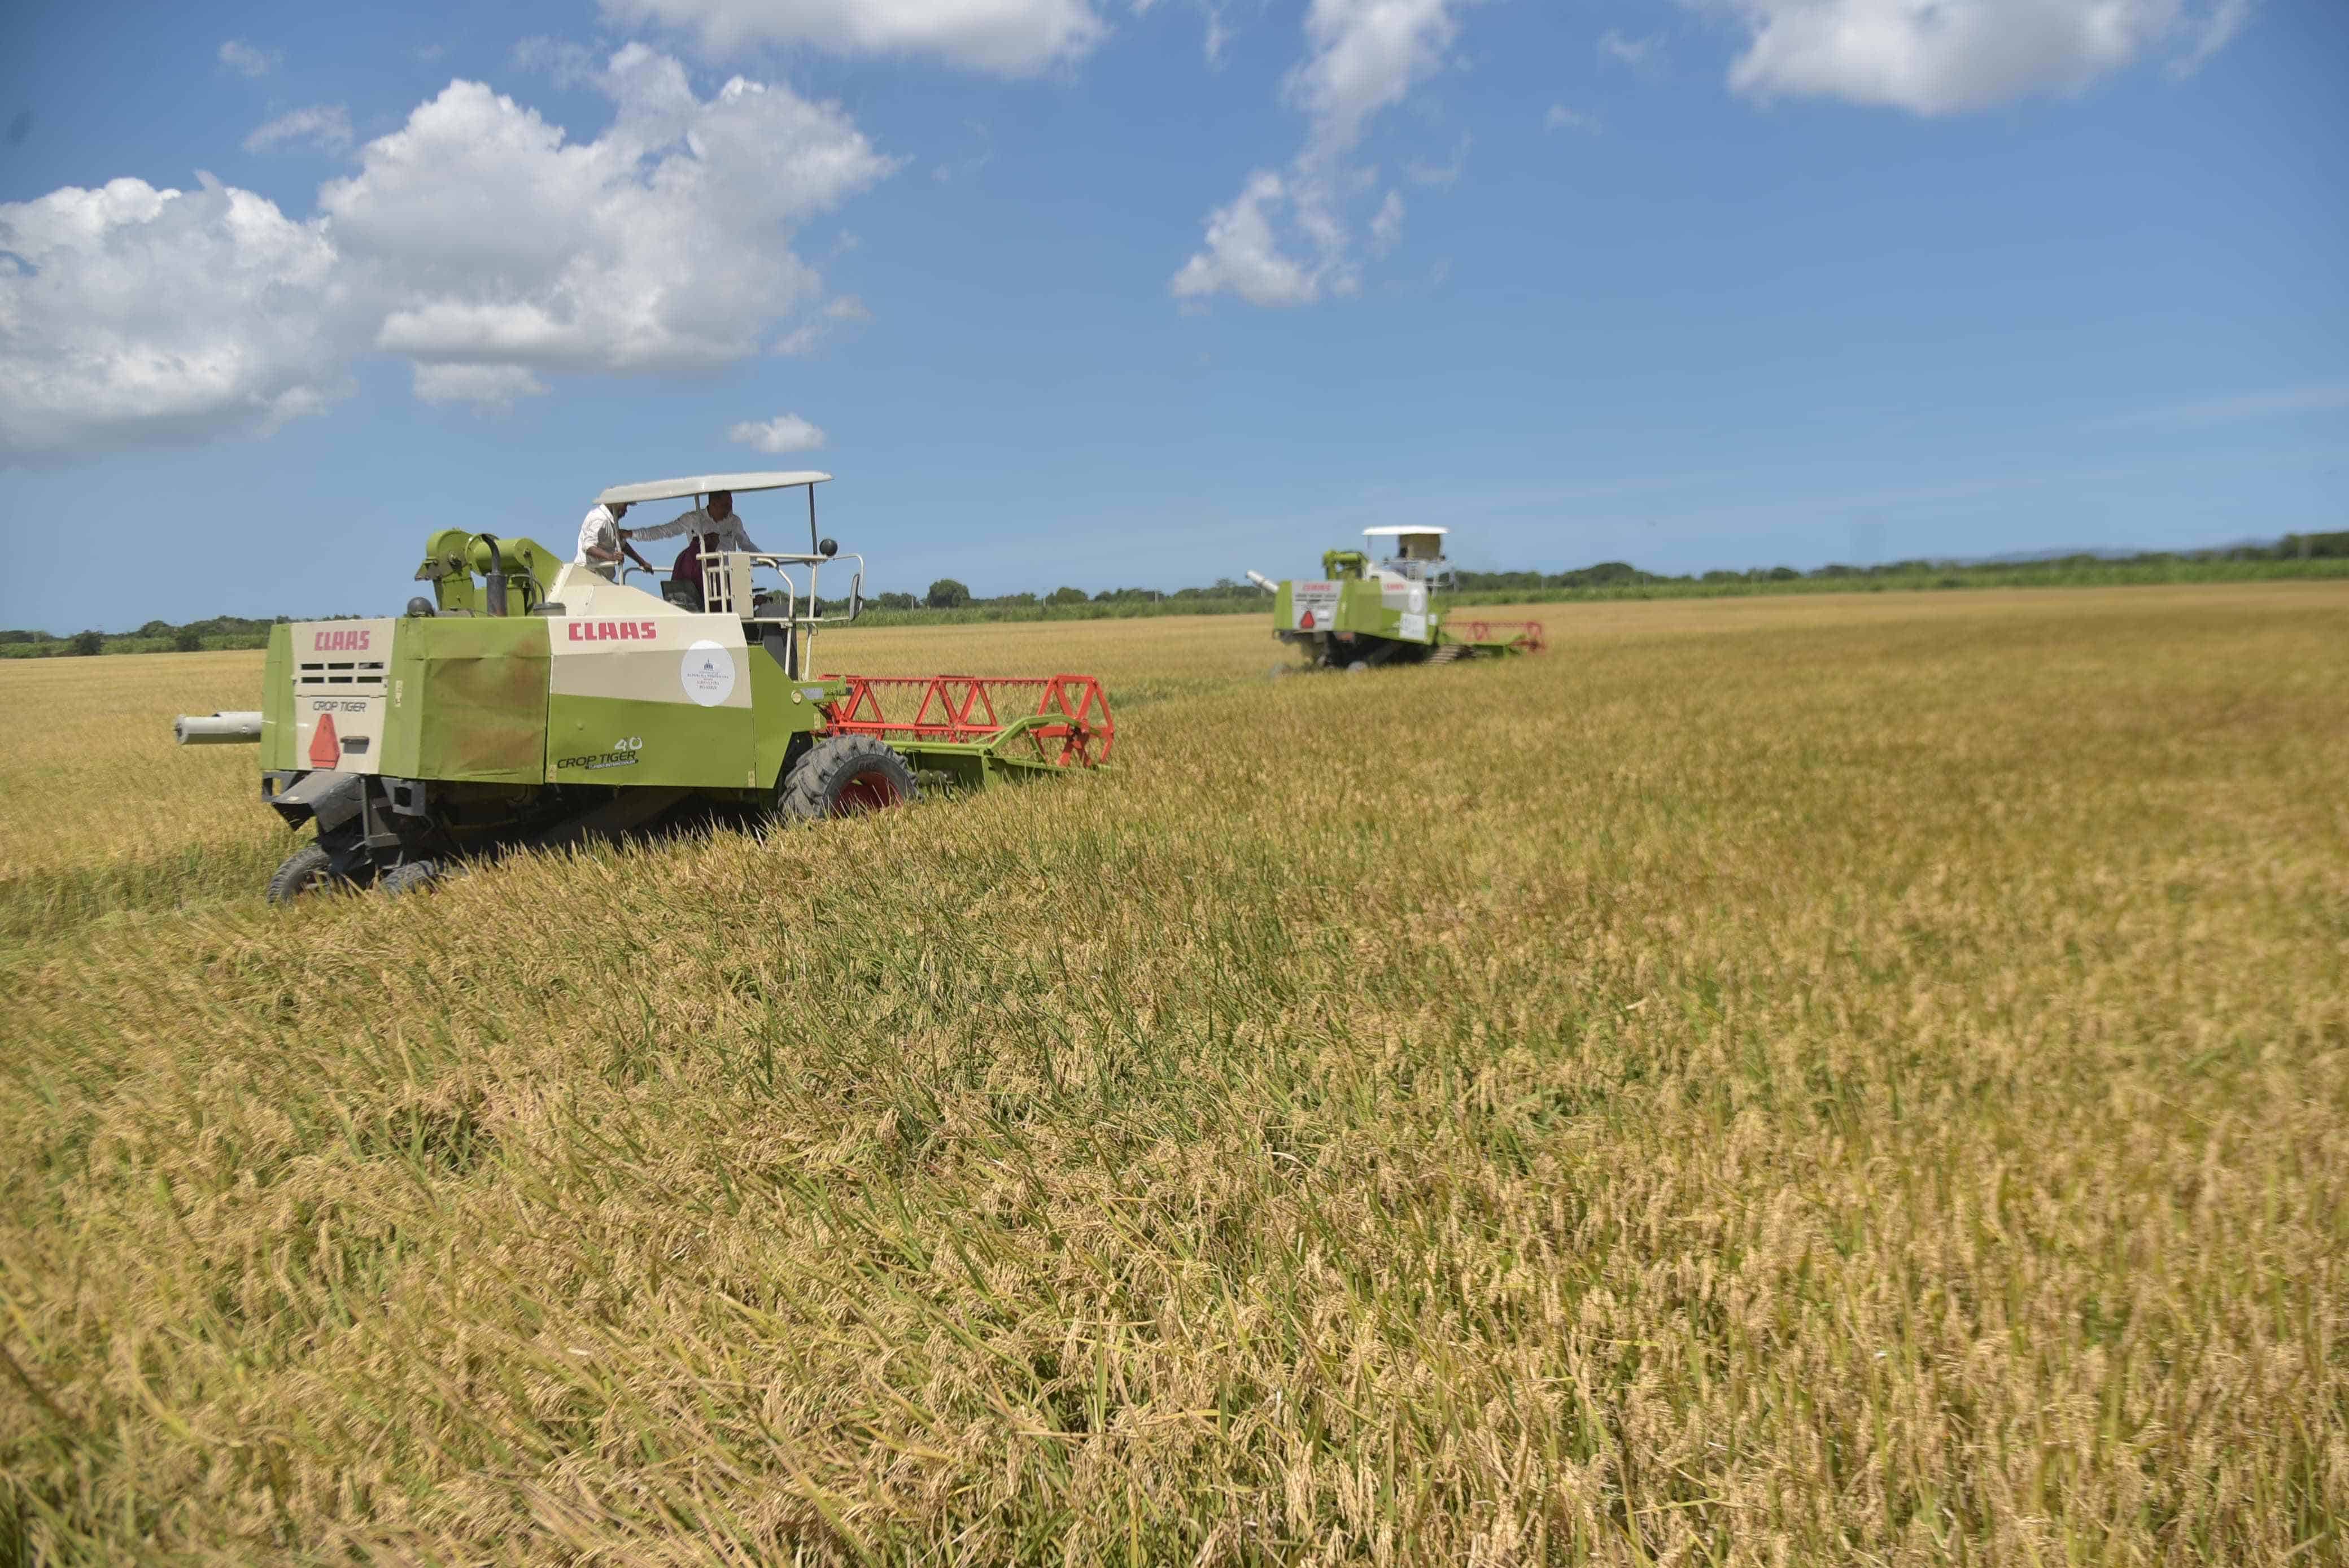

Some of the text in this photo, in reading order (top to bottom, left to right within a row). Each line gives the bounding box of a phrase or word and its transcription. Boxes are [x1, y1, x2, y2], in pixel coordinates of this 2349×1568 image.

[315, 631, 370, 650] CLAAS
[569, 622, 657, 641] CLAAS
[313, 701, 366, 712] CROP TIGER
[614, 736, 643, 751] 40
[557, 755, 597, 769] CROP
[599, 750, 636, 764] TIGER
